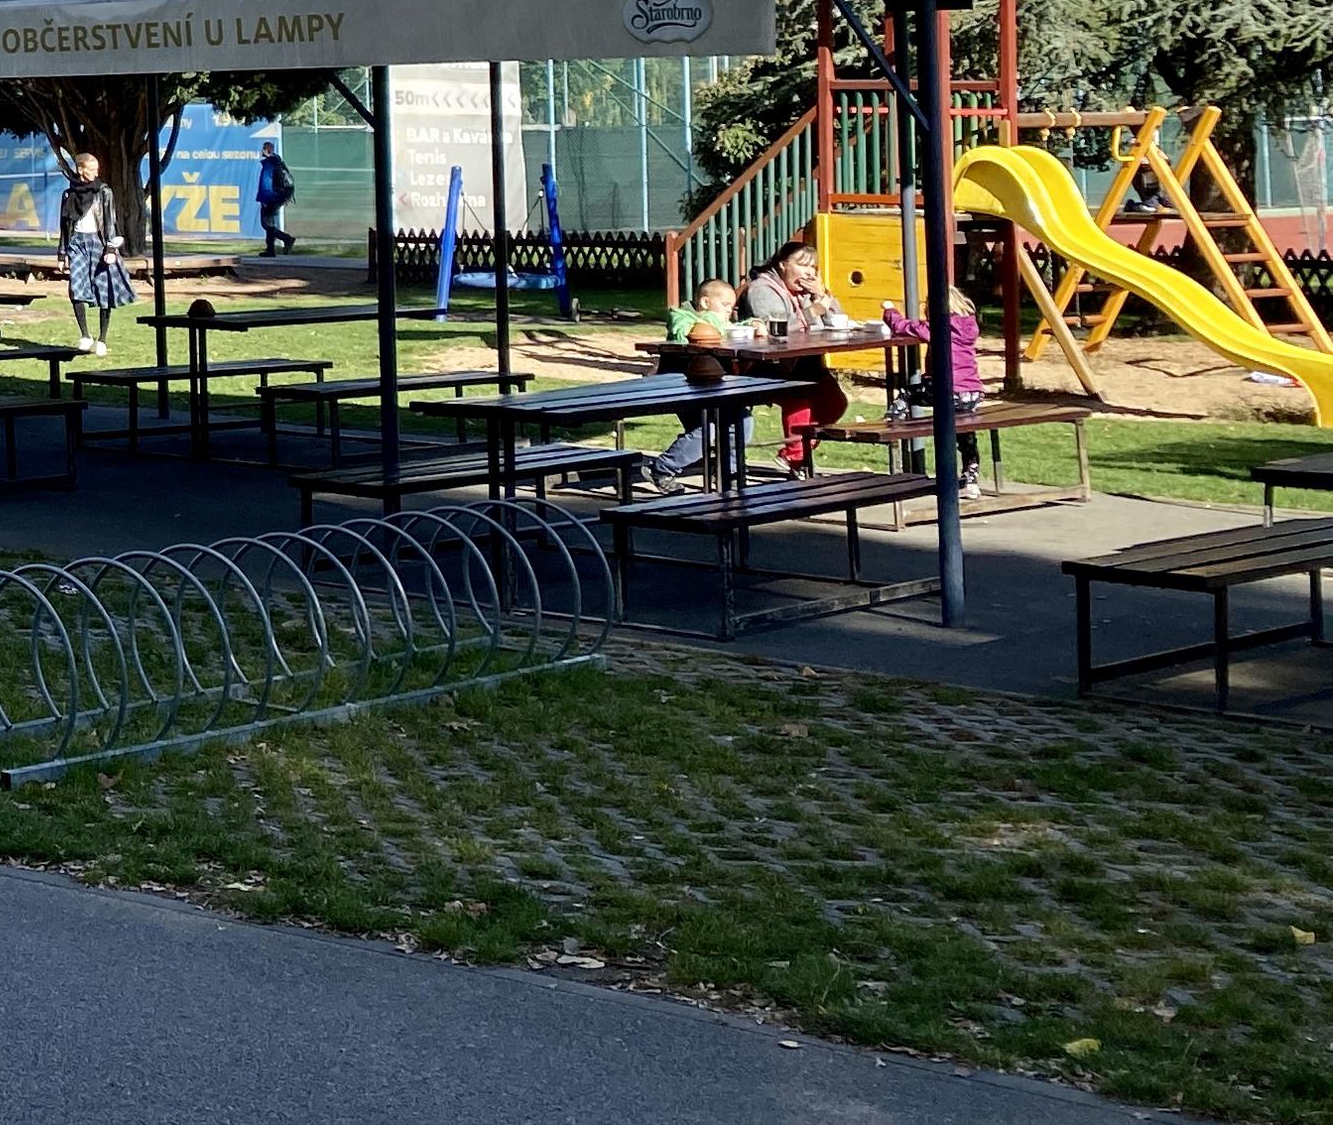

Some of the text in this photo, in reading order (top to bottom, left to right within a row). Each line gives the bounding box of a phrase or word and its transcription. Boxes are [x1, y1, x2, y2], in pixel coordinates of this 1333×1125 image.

[1, 13, 345, 54] OBČERSTVENÍ U LAMPY
[395, 90, 429, 106] 50m
[405, 127, 440, 144] BAR
[442, 132, 450, 144] a
[177, 151, 190, 160] na
[192, 149, 220, 160] celou
[407, 148, 447, 165] Tenis
